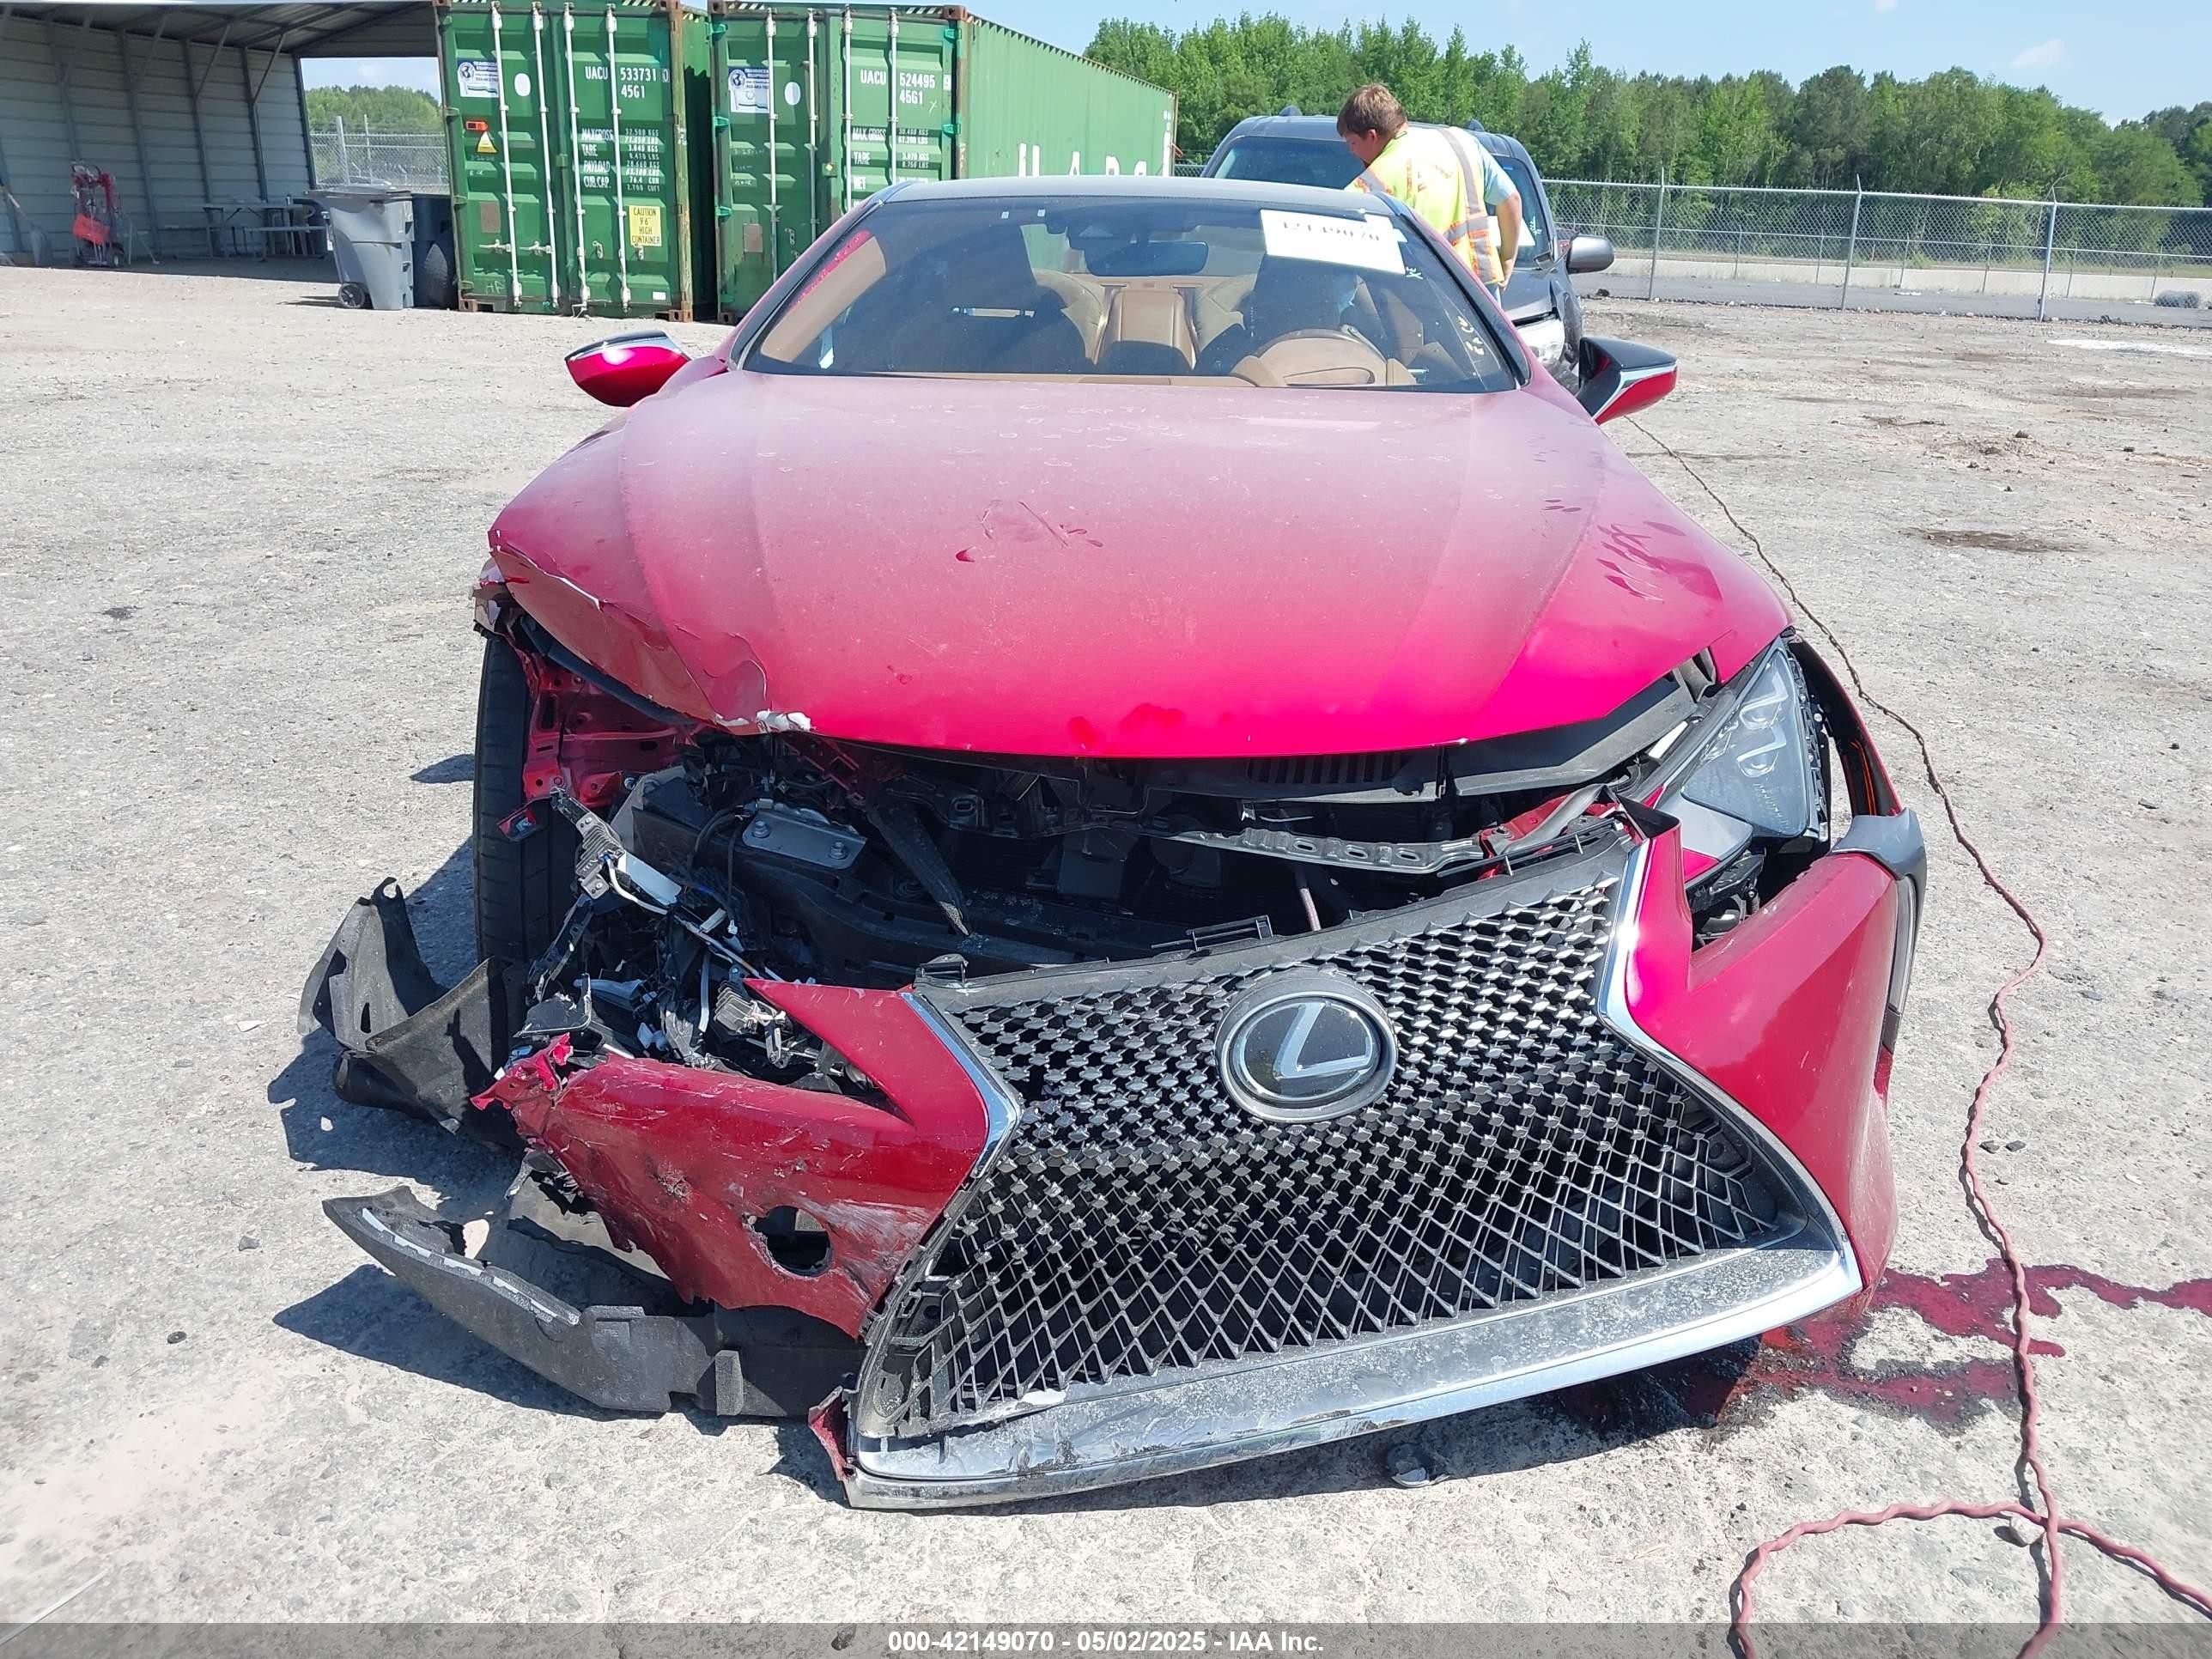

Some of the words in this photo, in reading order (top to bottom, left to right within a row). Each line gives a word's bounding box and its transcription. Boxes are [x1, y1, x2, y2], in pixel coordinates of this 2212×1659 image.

[585, 66, 608, 80] UACU
[620, 67, 657, 82] 533731
[663, 68, 670, 82] 0
[860, 69, 887, 85] UACU
[899, 72, 935, 88] 524495
[621, 84, 645, 99] 45G1
[899, 89, 923, 105] 45G1
[647, 129, 659, 137] KGS
[854, 151, 871, 166] TARE
[583, 159, 611, 173] PAYLOAD
[633, 207, 657, 216] CAUTION
[639, 226, 653, 235] HIGH
[631, 235, 660, 245] CONTAINER
